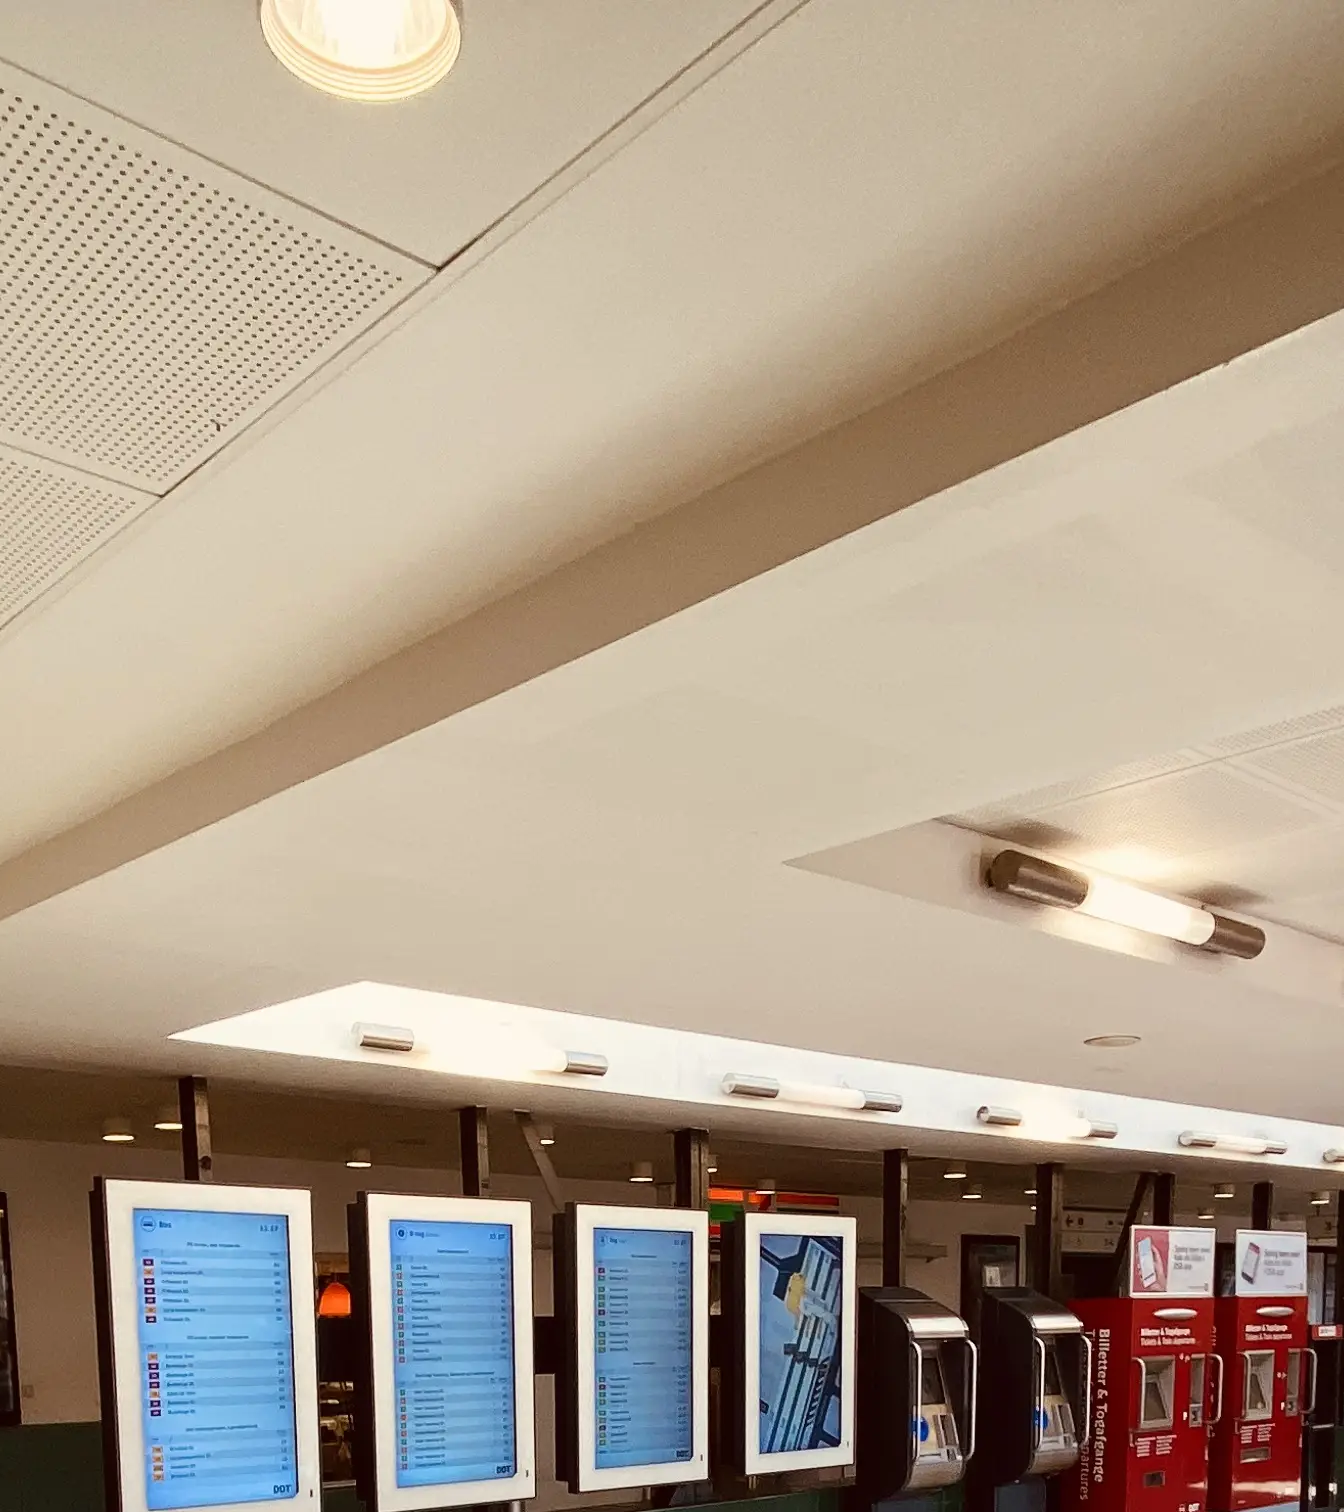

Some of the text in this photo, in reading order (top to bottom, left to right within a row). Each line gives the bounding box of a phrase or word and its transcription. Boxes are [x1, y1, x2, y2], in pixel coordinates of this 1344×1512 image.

[1092, 1328, 1111, 1483] Billetter & Togafgange
[273, 1484, 292, 1494] DOT
